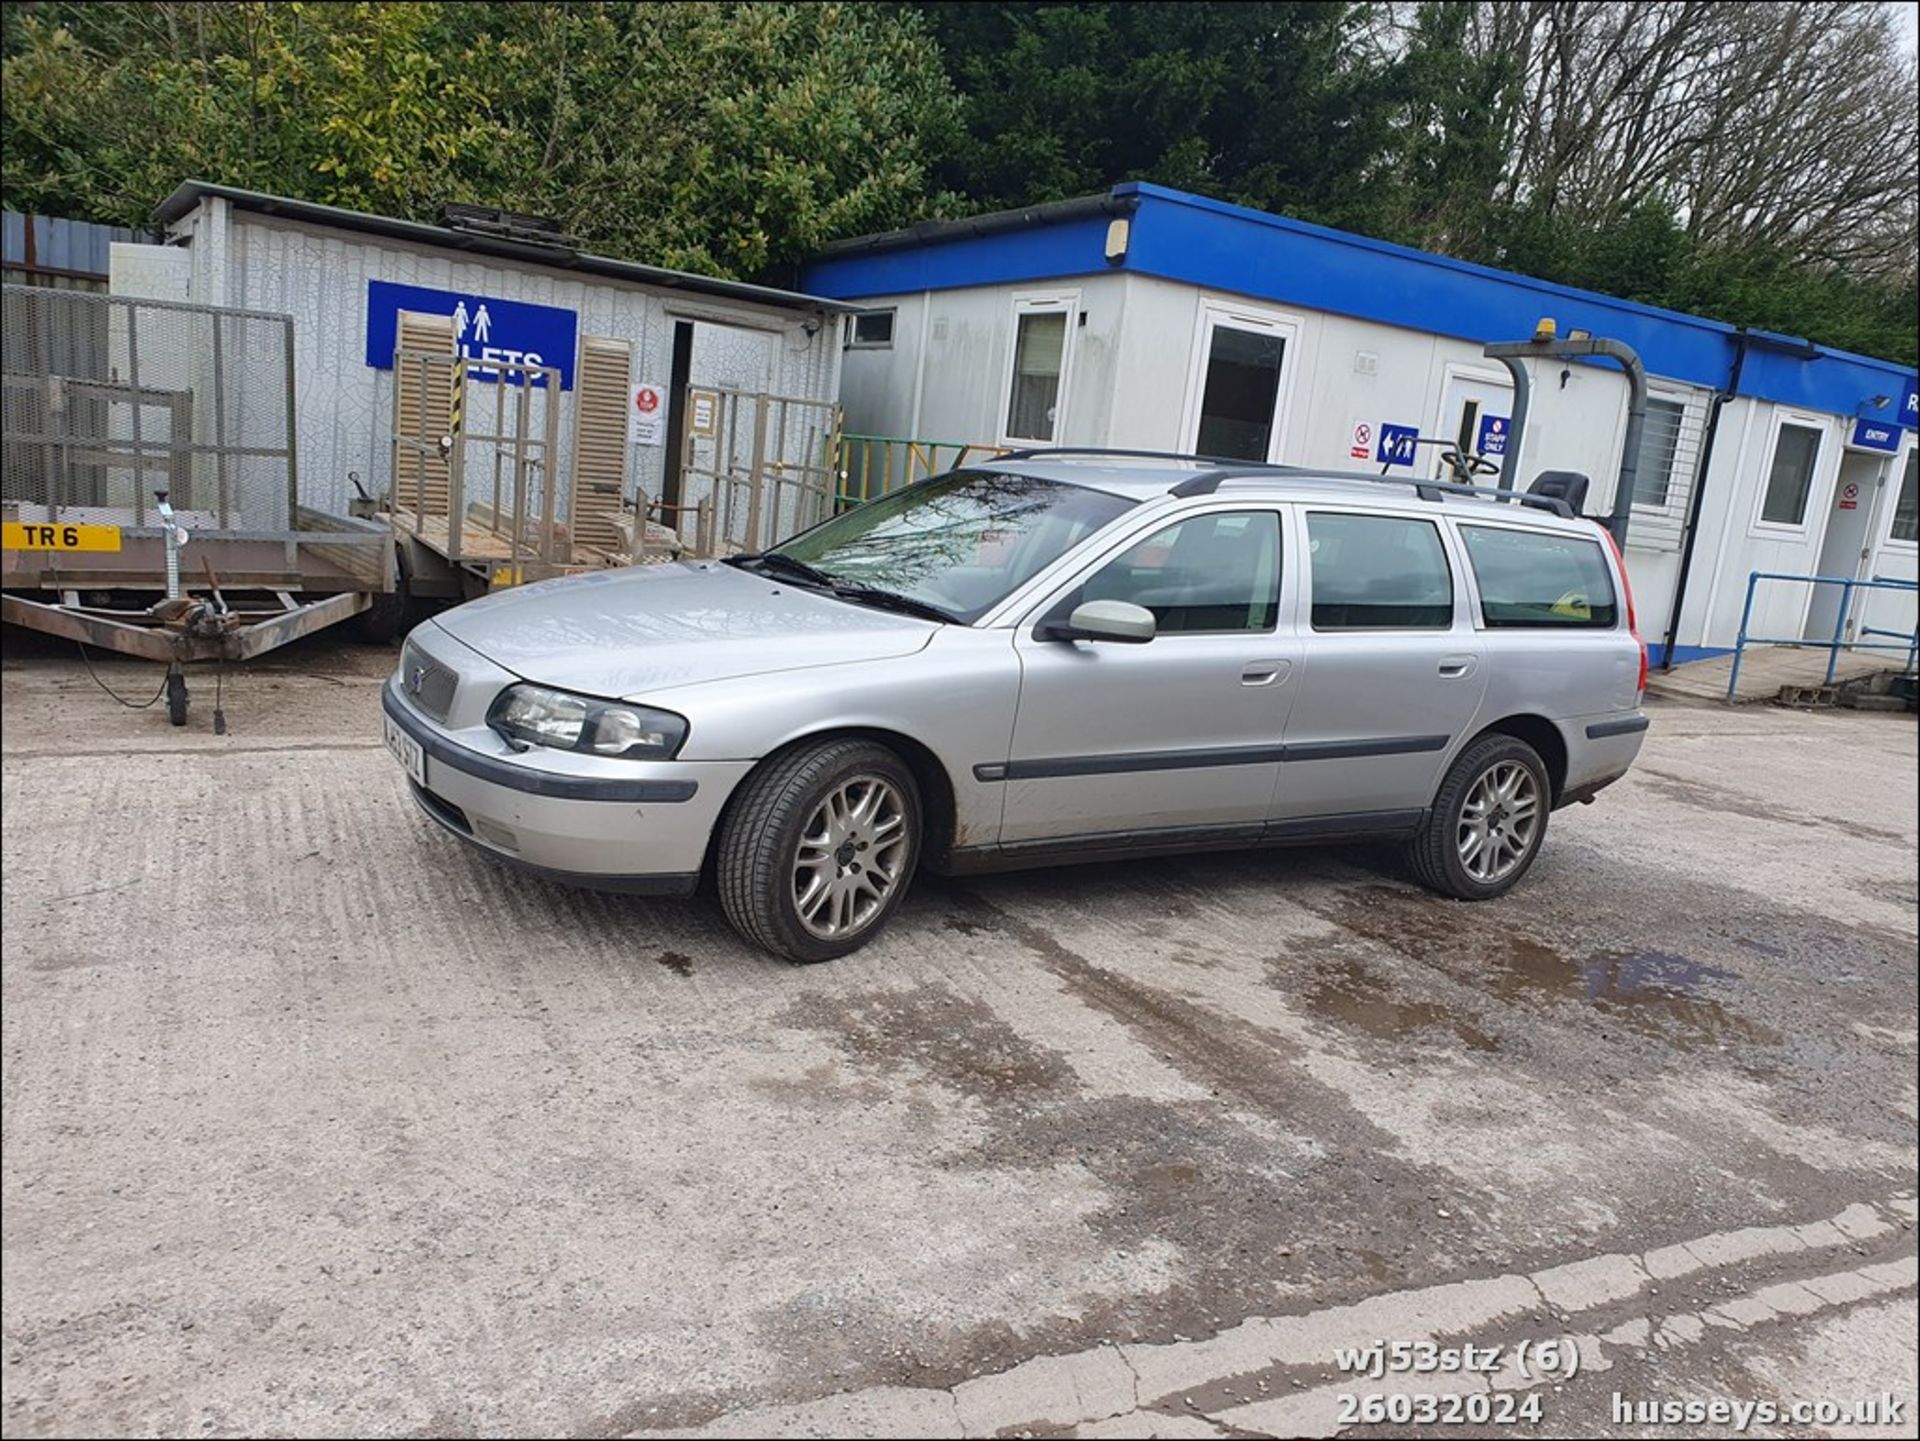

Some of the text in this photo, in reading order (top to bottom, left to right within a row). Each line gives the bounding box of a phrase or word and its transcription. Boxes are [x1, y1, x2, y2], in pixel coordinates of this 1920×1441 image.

[456, 343, 543, 379] LETS
[1484, 442, 1503, 452] ONLY
[22, 526, 79, 546] TR 6
